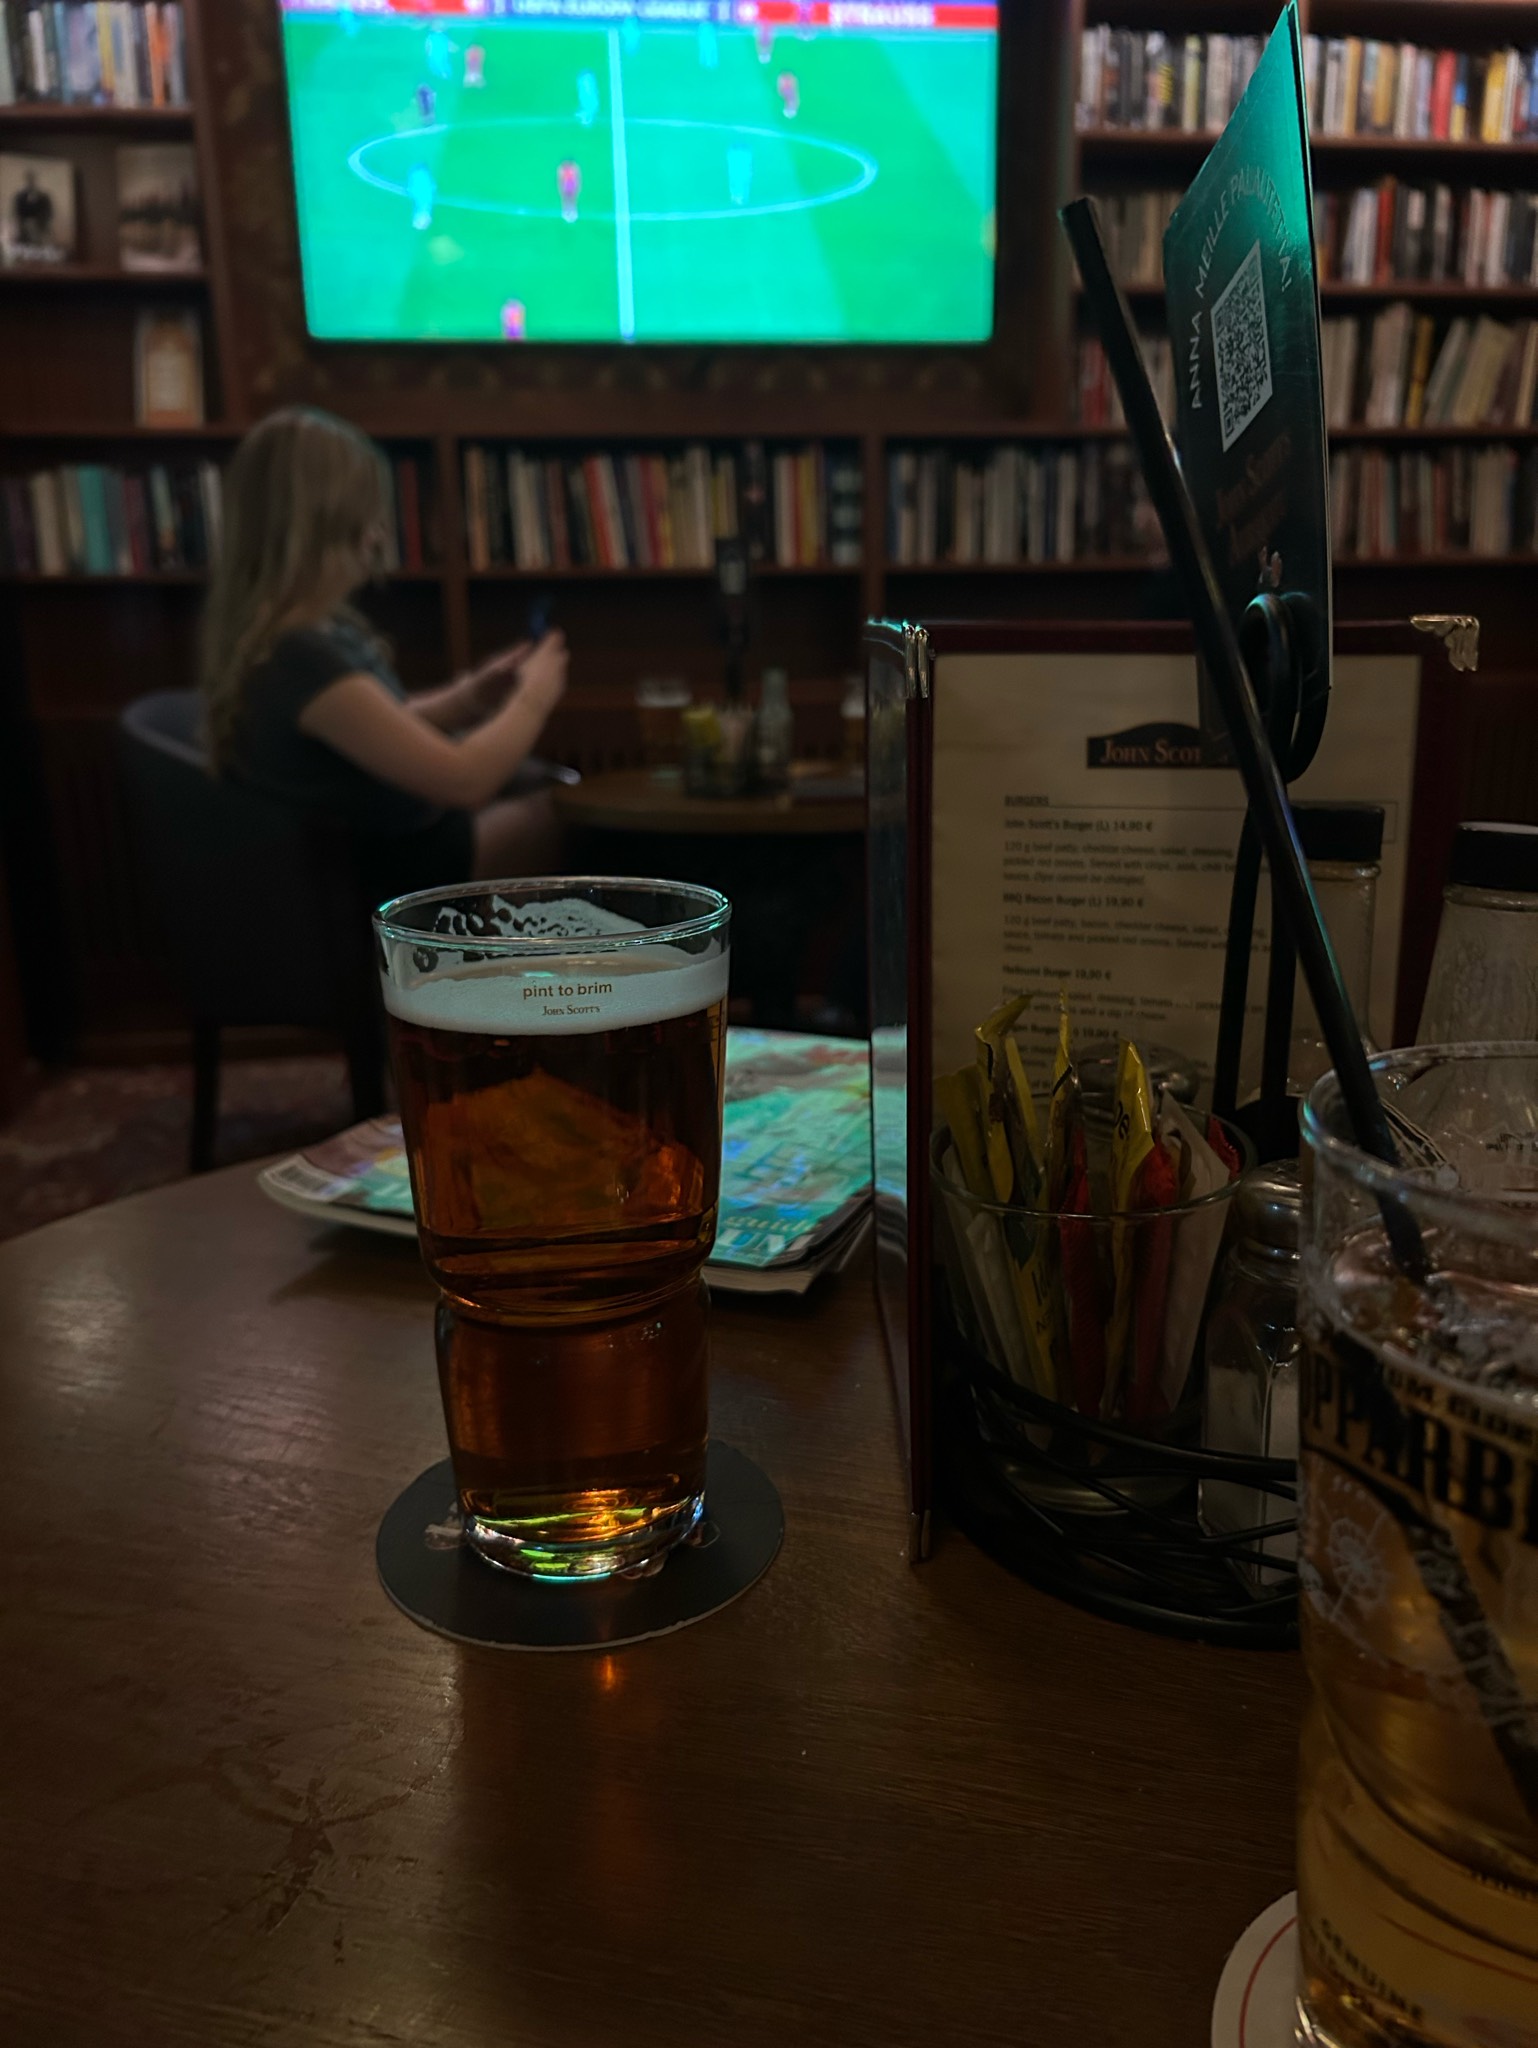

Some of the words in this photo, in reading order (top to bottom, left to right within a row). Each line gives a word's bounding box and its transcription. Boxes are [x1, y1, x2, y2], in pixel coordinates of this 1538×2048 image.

[1189, 311, 1203, 410] ANNA
[523, 985, 553, 1000] pint
[558, 984, 573, 996] to
[577, 982, 612, 995] brim
